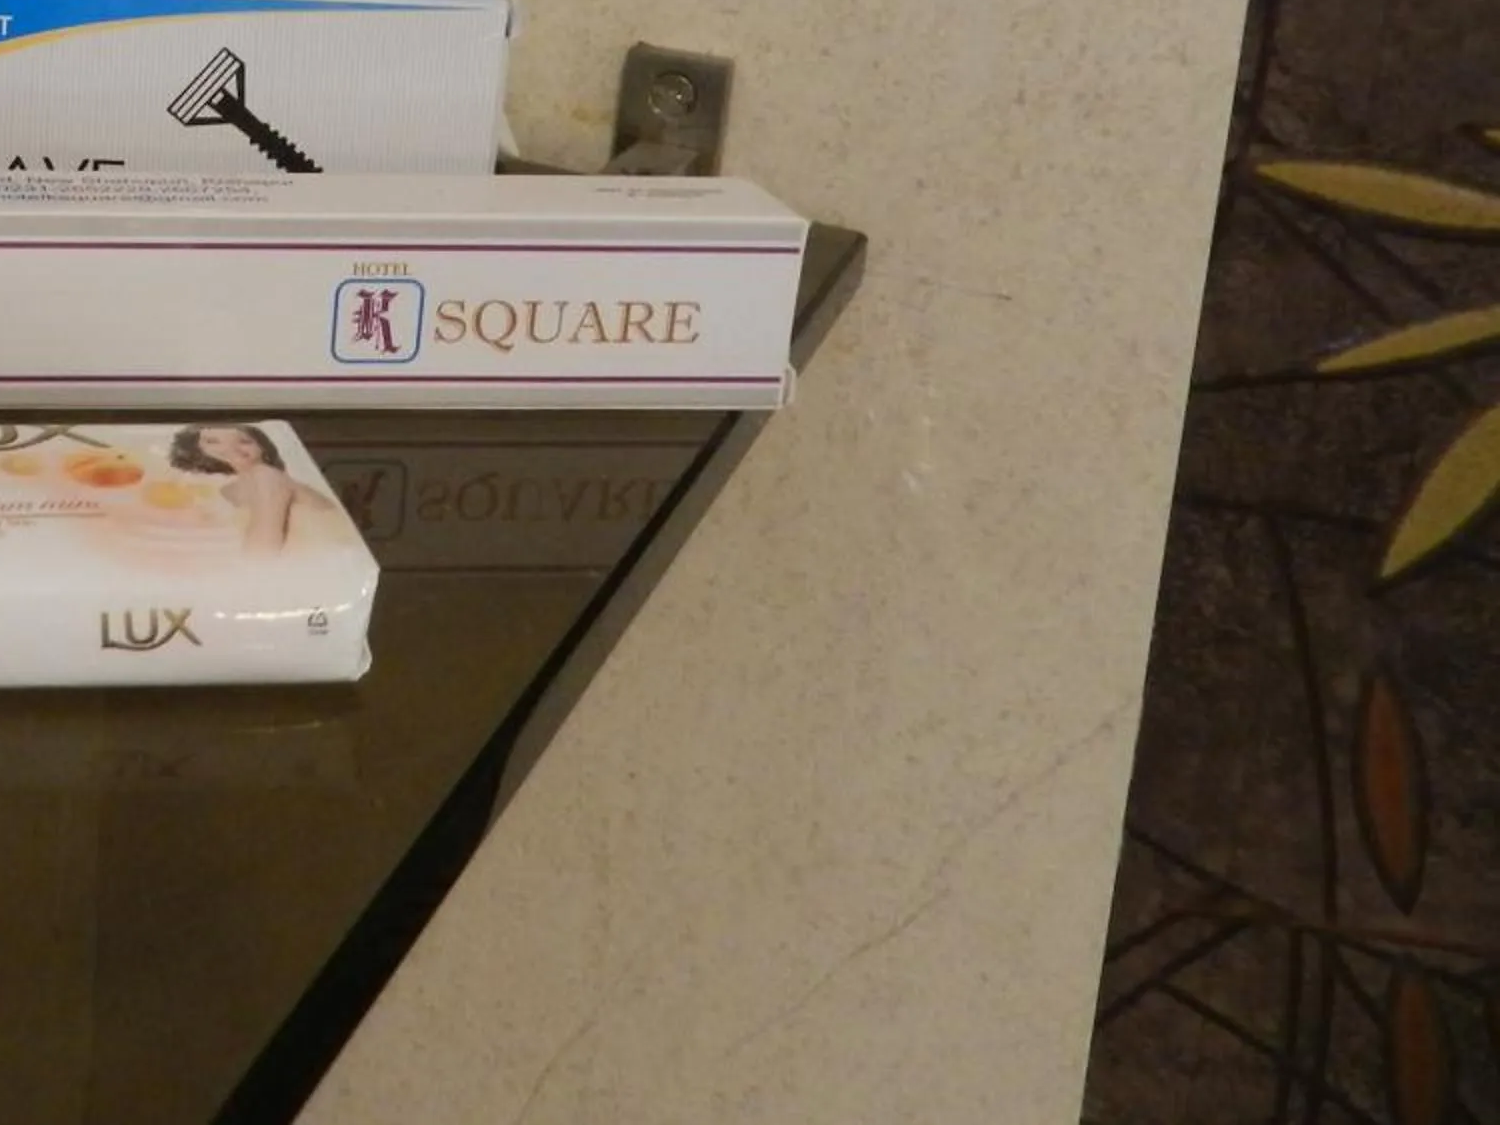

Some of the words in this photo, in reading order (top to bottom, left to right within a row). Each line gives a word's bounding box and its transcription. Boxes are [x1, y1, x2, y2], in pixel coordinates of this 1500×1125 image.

[353, 261, 411, 277] HOTEL
[433, 299, 702, 354] SQUARE
[101, 607, 202, 652] LUX
